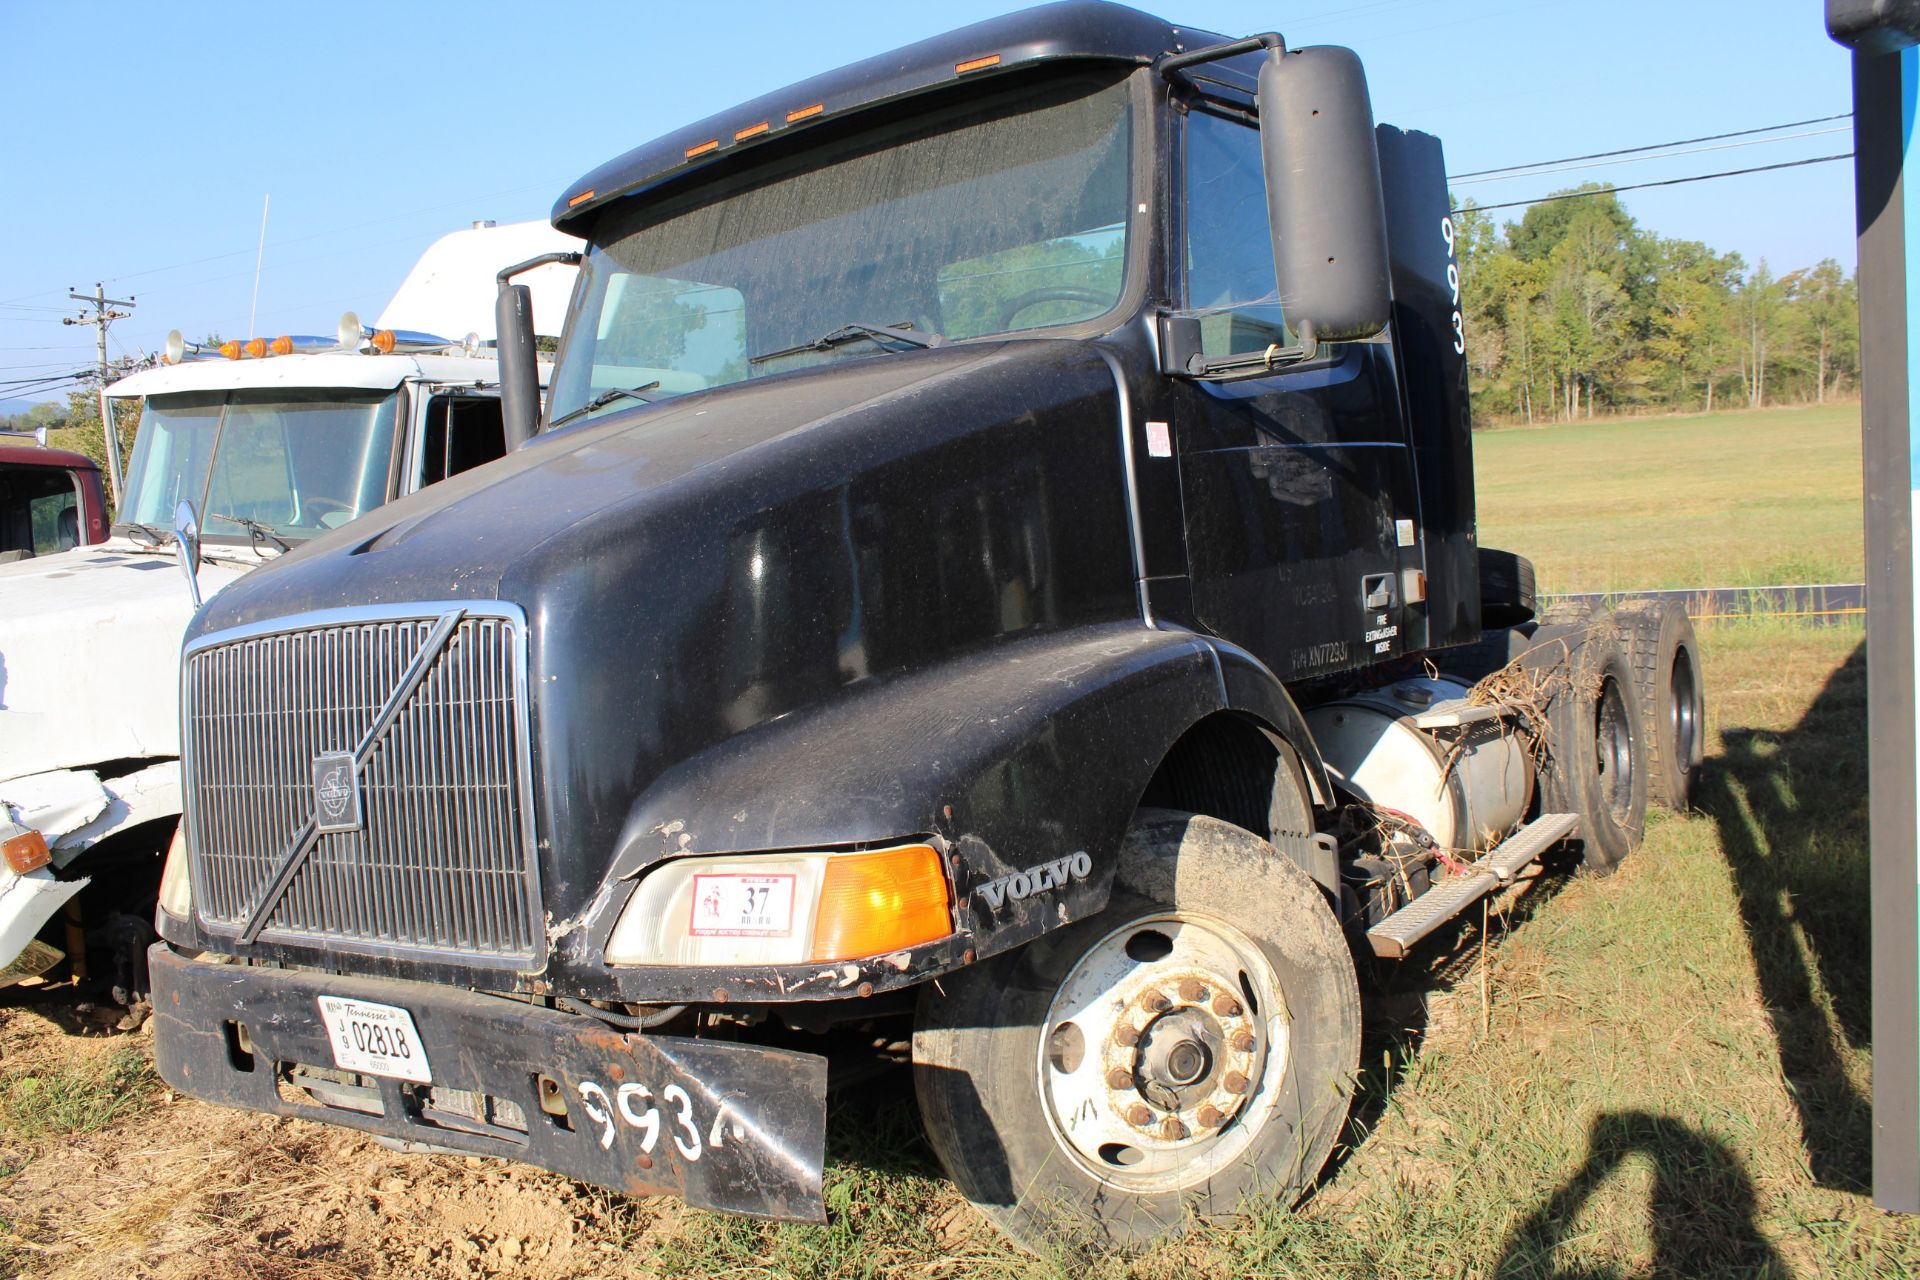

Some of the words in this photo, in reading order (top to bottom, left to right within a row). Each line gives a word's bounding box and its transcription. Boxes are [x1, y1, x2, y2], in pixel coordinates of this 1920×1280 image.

[975, 850, 1092, 912] VOLVO
[743, 886, 770, 915] 37
[344, 1003, 389, 1021] Tennessee
[352, 1021, 411, 1059] 02818
